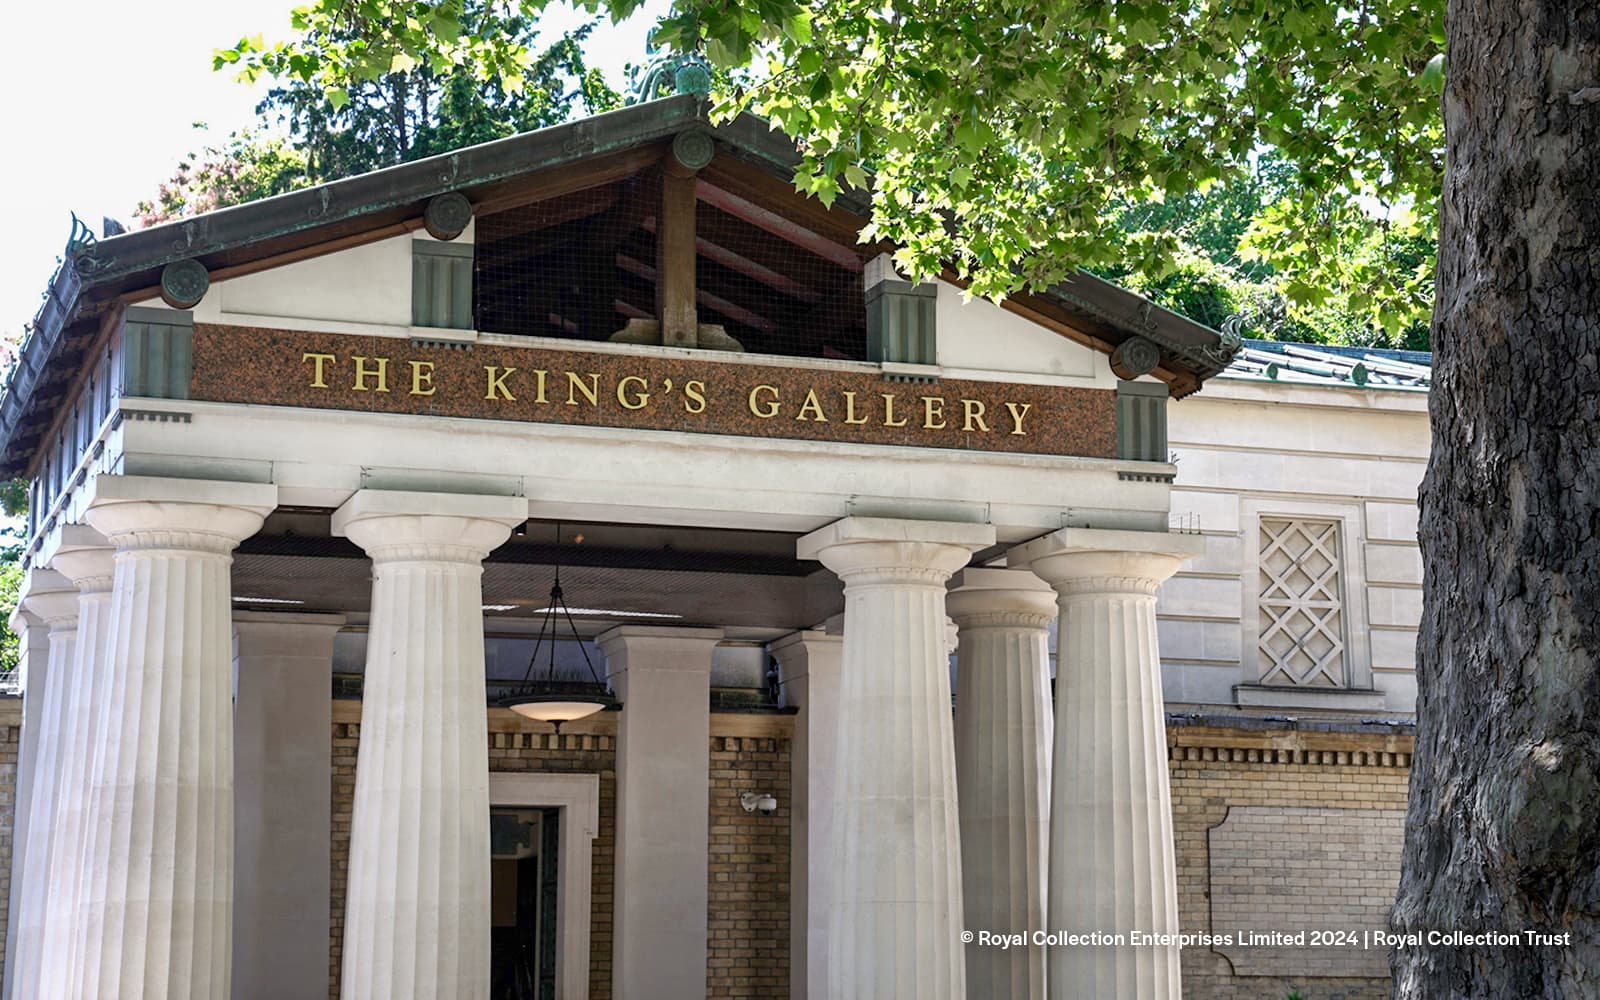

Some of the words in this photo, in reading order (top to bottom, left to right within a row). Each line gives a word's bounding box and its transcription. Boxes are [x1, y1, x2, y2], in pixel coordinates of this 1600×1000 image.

[302, 353, 437, 397] THE
[483, 366, 706, 414] KING’S
[748, 384, 1032, 436] GALLERY
